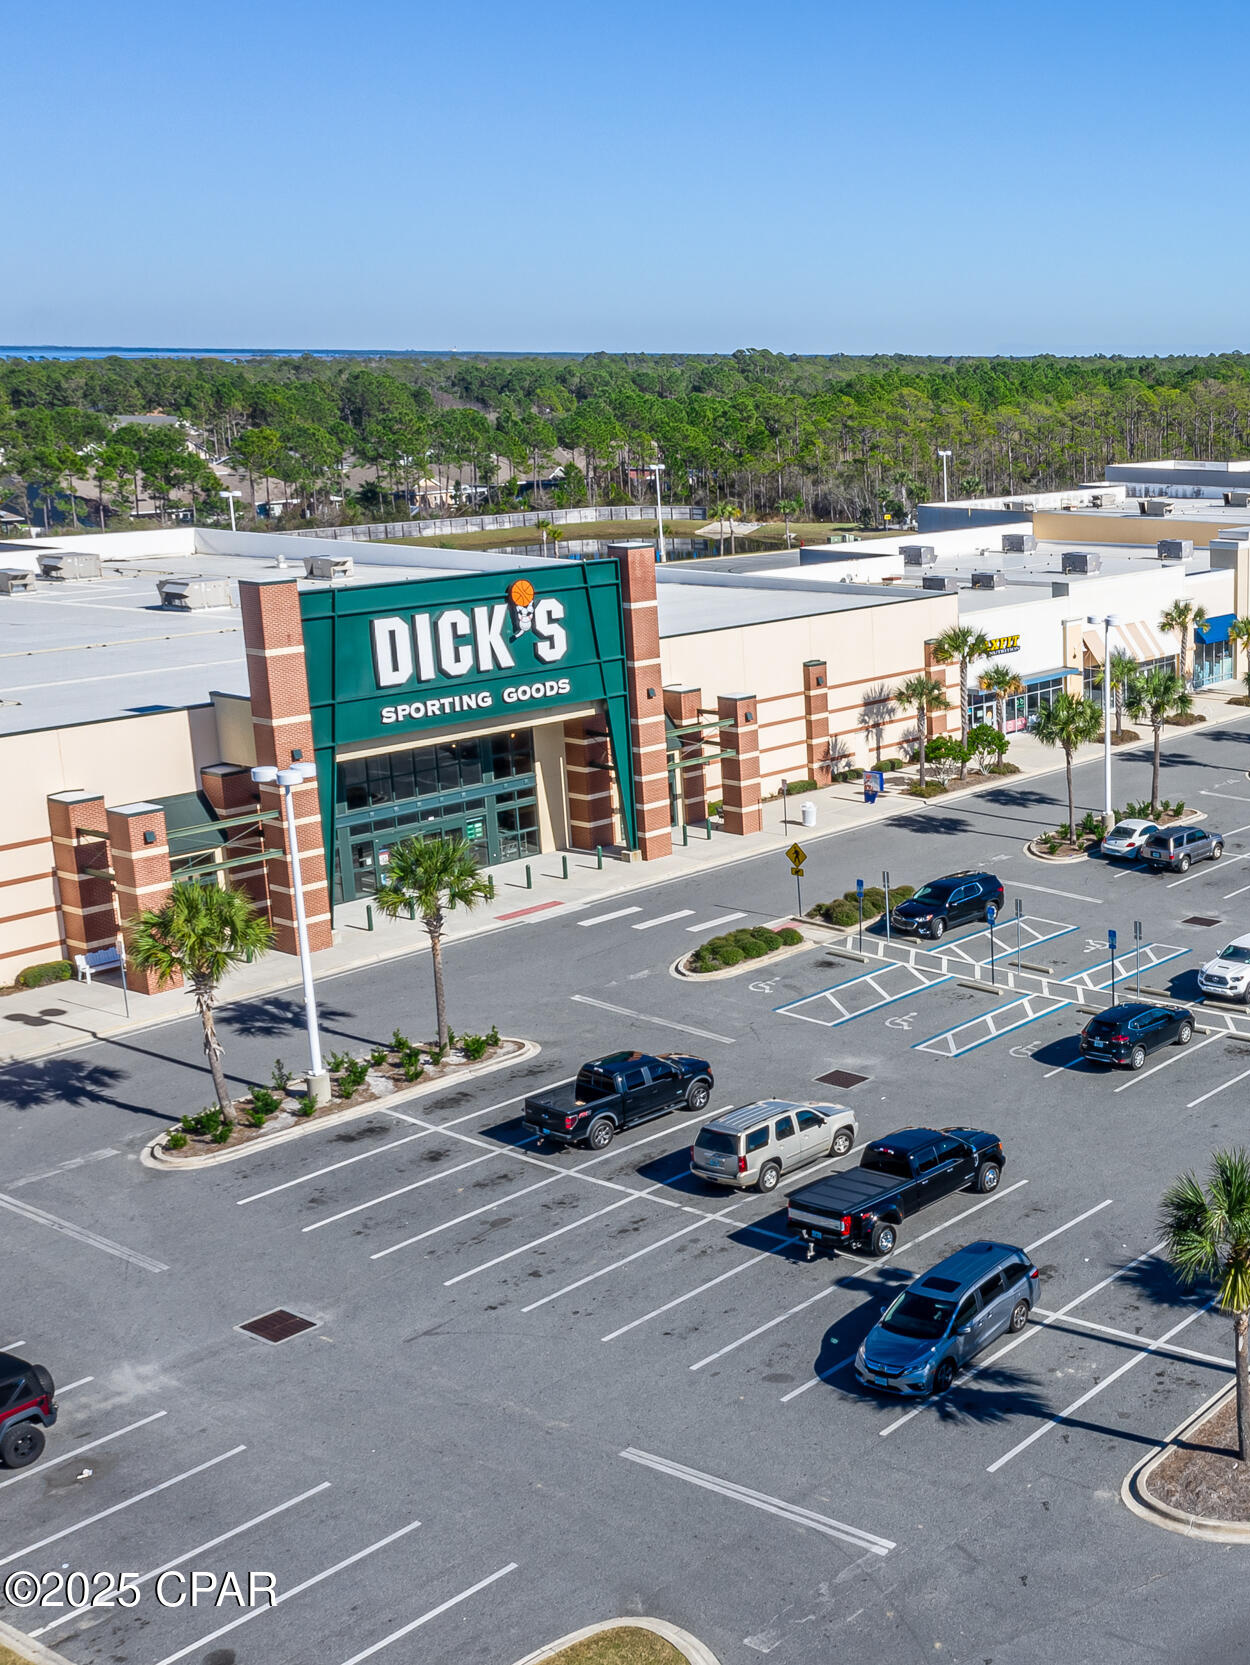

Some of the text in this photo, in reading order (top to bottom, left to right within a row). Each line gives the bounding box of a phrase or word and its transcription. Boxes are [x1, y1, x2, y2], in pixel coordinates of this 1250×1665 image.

[373, 580, 569, 688] DICK'S
[380, 678, 571, 725] SPORTING GOODS
